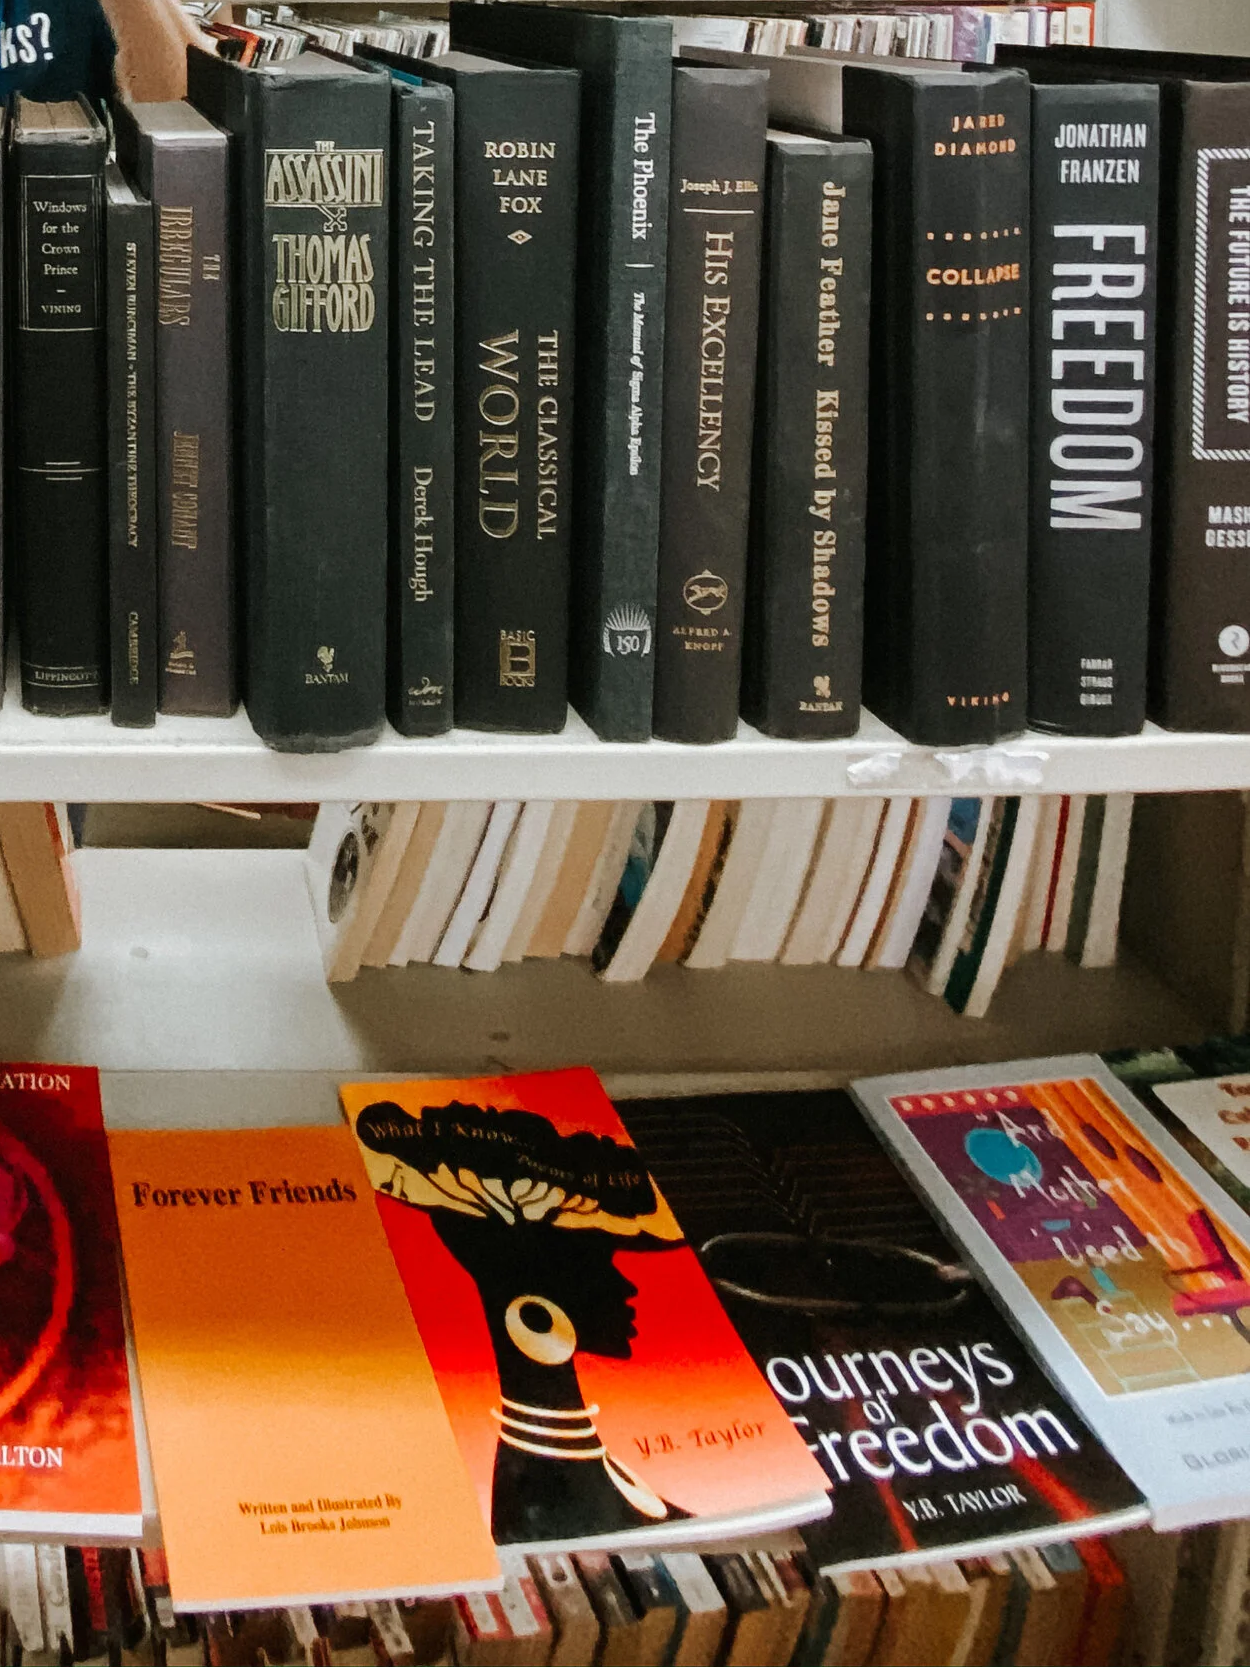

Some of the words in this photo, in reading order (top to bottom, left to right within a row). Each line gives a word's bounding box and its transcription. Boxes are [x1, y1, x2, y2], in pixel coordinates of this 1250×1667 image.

[633, 113, 656, 153] The
[952, 114, 1005, 132] JARED
[1055, 123, 1147, 149] JONATHAN
[484, 142, 556, 158] ROBIN
[934, 139, 1016, 156] DIAMOND
[412, 121, 435, 248] TAKING
[493, 169, 547, 186] LANE
[1060, 159, 1140, 183] FRANZEN
[33, 201, 87, 213] Windows
[499, 196, 542, 213] FOX
[632, 159, 654, 240] Phoenix
[821, 181, 846, 248] Jane
[41, 242, 80, 255] Crown
[42, 222, 58, 234] for
[62, 222, 79, 234] the
[44, 264, 78, 275] Prince
[272, 234, 374, 283] THOMAS
[704, 231, 734, 285] HIS
[926, 263, 1020, 285] COLLAPSE
[272, 284, 375, 332] GIFFORD
[413, 258, 435, 327] THE
[817, 257, 843, 367] Feather
[414, 337, 436, 421] LEAD
[537, 330, 558, 387] THE
[1050, 225, 1146, 530] FREEDOM
[697, 295, 731, 492] EXCELLENCY
[478, 329, 519, 539] WORLD
[814, 389, 839, 480] Kissed
[537, 396, 559, 540] CLASSICAL
[414, 466, 434, 528] Derek
[809, 488, 837, 522] by
[409, 533, 434, 602] Hough
[812, 530, 836, 647] Shadows
[133, 1181, 241, 1208] Forever
[252, 1176, 358, 1204] Friends
[766, 1342, 1016, 1413] ourneys
[863, 1388, 896, 1426] of
[687, 1420, 767, 1451] Taylor
[238, 1500, 287, 1517] Written
[317, 1496, 381, 1512] Illustrated
[948, 1482, 1028, 1515] TAYLOR
